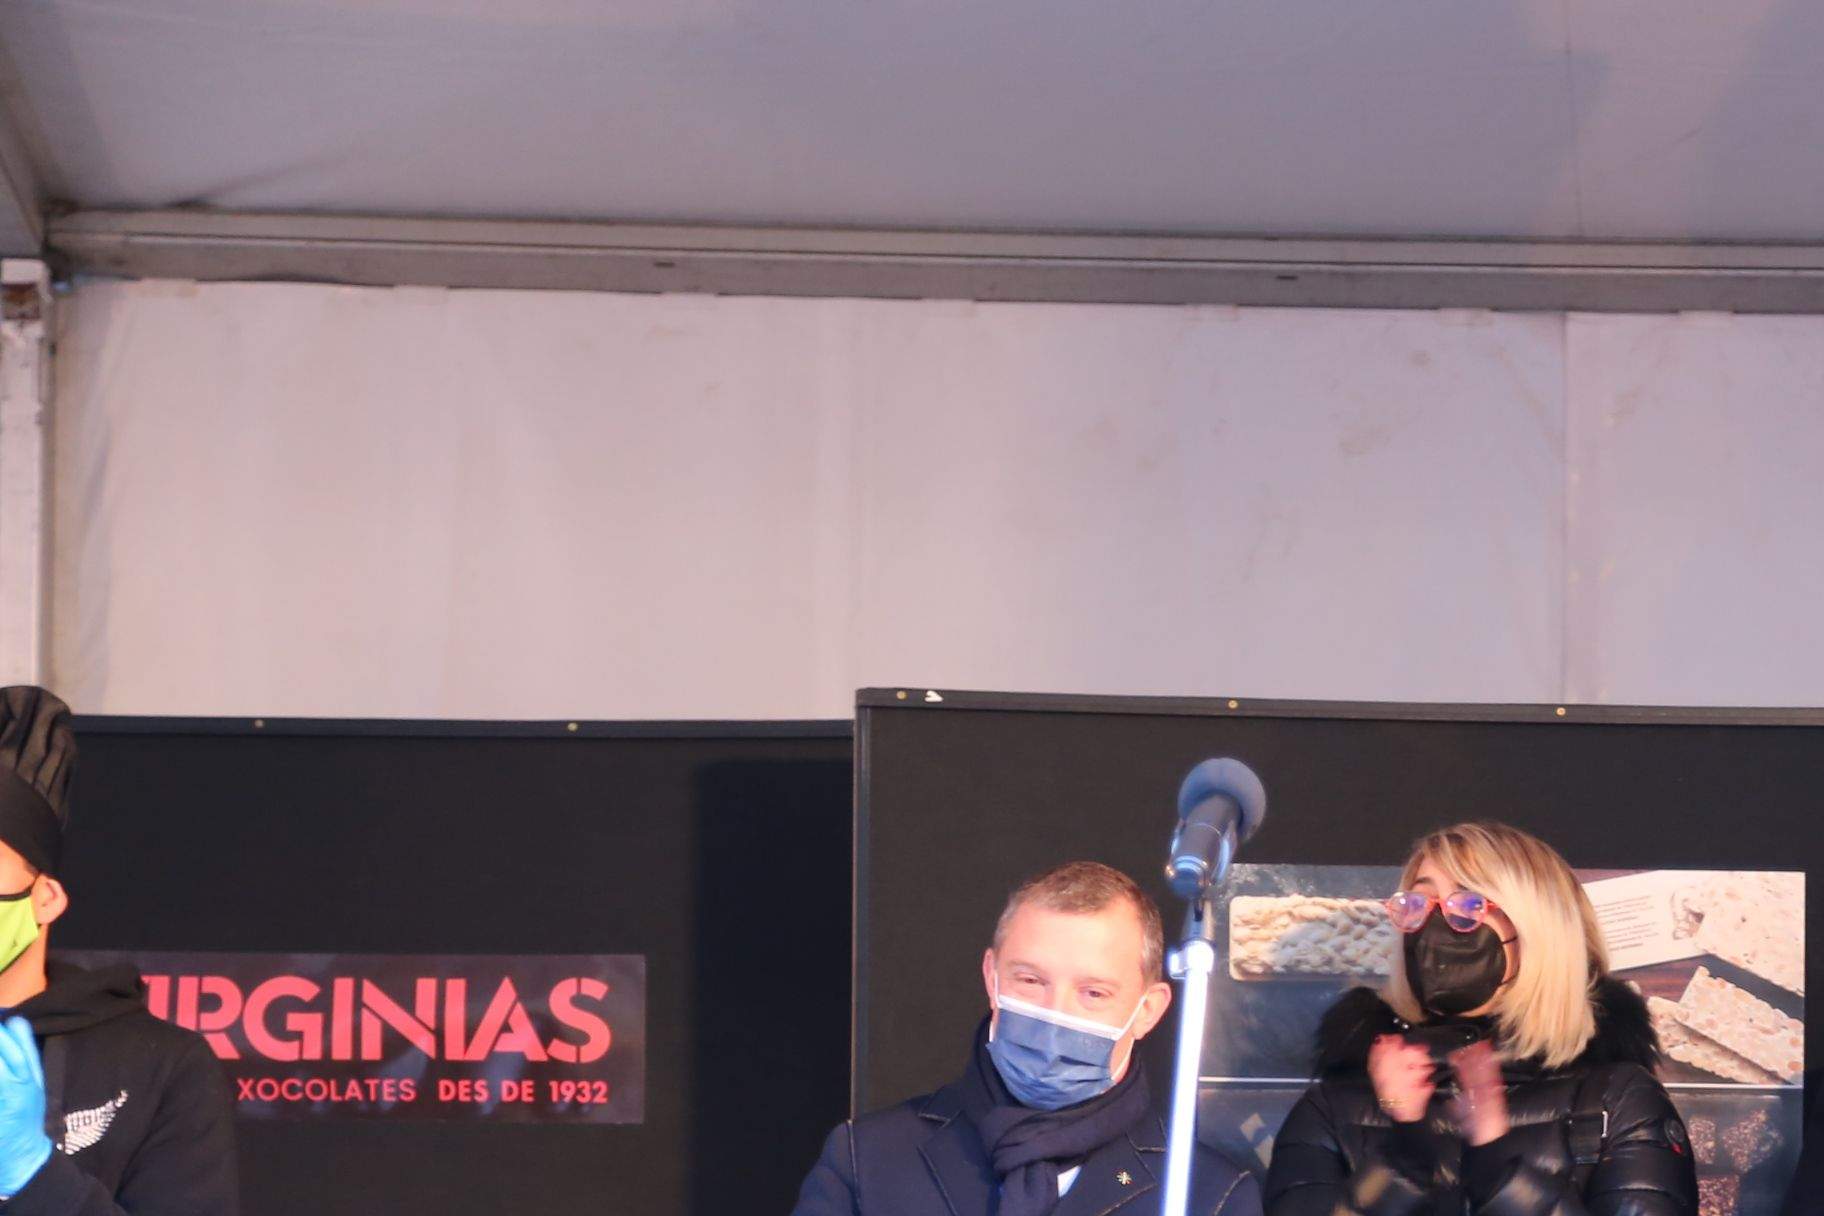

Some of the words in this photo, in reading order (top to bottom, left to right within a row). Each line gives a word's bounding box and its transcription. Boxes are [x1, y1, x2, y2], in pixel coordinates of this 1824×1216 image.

[142, 974, 612, 1064] IRGINIAS
[237, 1077, 417, 1102] XOCOLATES
[438, 1079, 489, 1103] DES
[502, 1080, 535, 1104] DE
[549, 1080, 609, 1105] 1932
